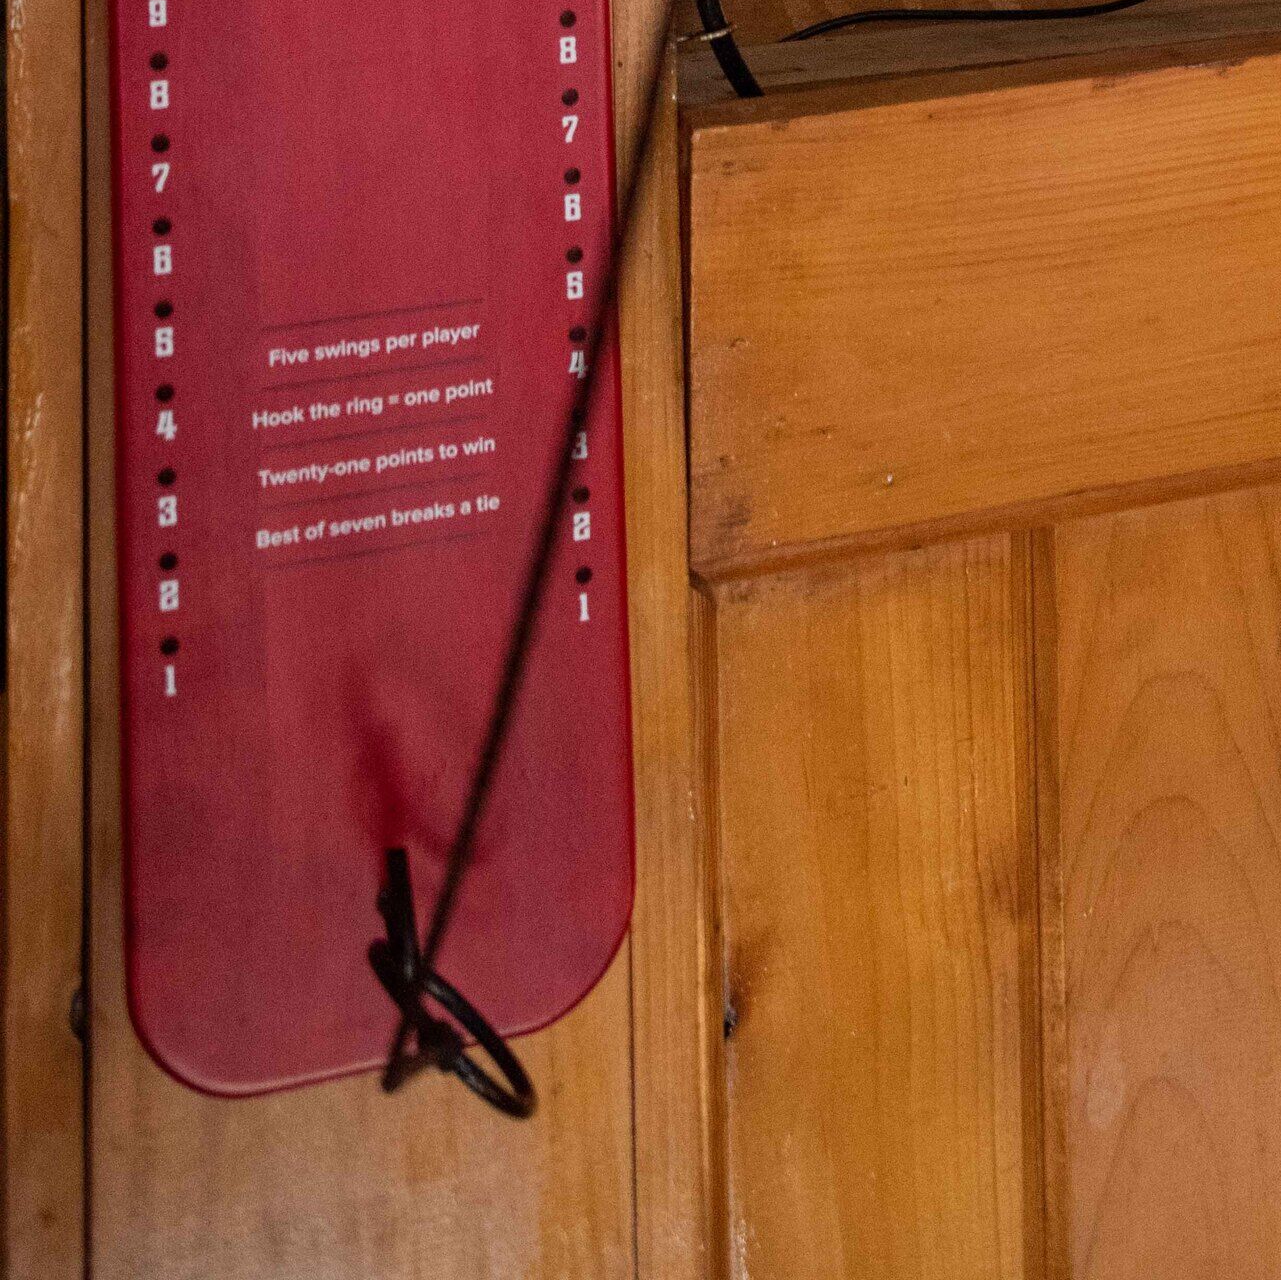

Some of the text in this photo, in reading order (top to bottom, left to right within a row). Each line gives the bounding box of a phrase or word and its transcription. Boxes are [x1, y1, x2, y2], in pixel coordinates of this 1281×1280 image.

[558, 35, 578, 65] 8
[149, 79, 170, 110] 8
[561, 114, 580, 144] 7
[151, 162, 171, 193] 7
[563, 192, 582, 222] 6
[153, 244, 173, 276] 6
[565, 270, 584, 301] 5
[154, 326, 175, 358] 5
[269, 324, 480, 367] Five swings per player
[568, 350, 588, 379] 4
[252, 406, 304, 429] Hook
[309, 402, 341, 420] the
[346, 396, 384, 415] ring
[404, 388, 440, 406] one
[445, 378, 494, 403] point
[156, 410, 178, 441] 4
[258, 436, 496, 488] Twenty-one points to win
[157, 495, 178, 527] 3
[256, 495, 500, 549] Best of seven breaks a tie
[572, 511, 591, 542] 2
[159, 579, 180, 612] 2
[578, 592, 590, 622] 1
[165, 665, 177, 696] 1
